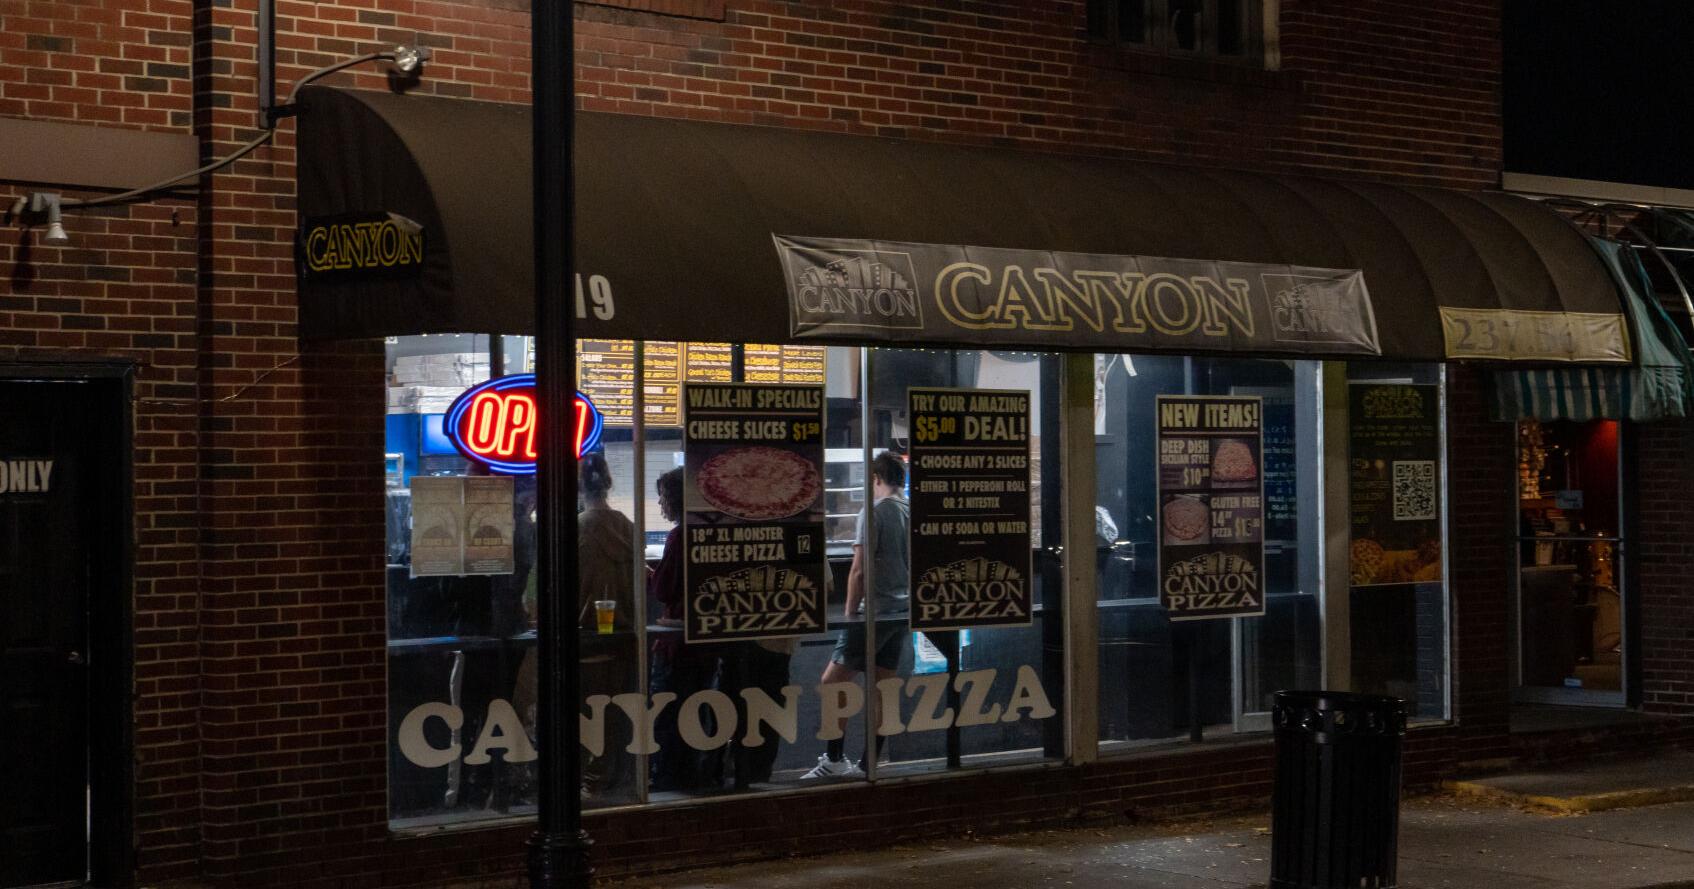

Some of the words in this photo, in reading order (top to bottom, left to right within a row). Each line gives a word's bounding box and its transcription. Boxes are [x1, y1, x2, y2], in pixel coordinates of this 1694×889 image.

[307, 219, 422, 271] CANYON
[800, 285, 916, 317] CANYON
[934, 261, 1255, 338] CANYON
[688, 388, 751, 408] WALK-IN
[757, 389, 821, 409] SPECIALS
[912, 395, 935, 411] TRY
[940, 395, 965, 412] OUR
[969, 396, 1026, 413] AMAZING
[467, 392, 587, 459] OP
[1161, 403, 1200, 428] NEW
[1204, 403, 1259, 428] ITEMS!
[689, 421, 739, 440] CHEESE
[744, 421, 787, 440] SLICES
[964, 416, 1026, 441] DEAL!
[1161, 440, 1185, 454] DEEP
[1187, 440, 1210, 454] DISH
[921, 455, 961, 469] CHOOSE
[963, 455, 985, 469] ANY
[987, 455, 994, 469] 2
[995, 455, 1026, 469] SLICES
[920, 481, 948, 493] EITHER
[951, 481, 957, 492] 1
[960, 481, 1004, 492] PEPPERONI
[1006, 480, 1026, 492] ROLL
[943, 497, 955, 509] OR
[957, 497, 964, 509] 2
[1210, 497, 1241, 509] GLUTEN
[1242, 496, 1260, 508] FREE
[717, 528, 730, 542] XL
[733, 527, 784, 541] MONSTER
[920, 523, 939, 535] CAN
[942, 522, 954, 534] OF
[955, 522, 980, 535] SODA
[982, 522, 995, 534] OR
[997, 521, 1027, 534] WATER
[1212, 527, 1233, 538] PIZZA
[691, 545, 739, 563] CHEESE
[744, 543, 786, 561] PIZZA
[916, 580, 1025, 604] CANYON
[1165, 573, 1258, 595] CANYON
[694, 589, 818, 615] CANYON
[919, 600, 1025, 621] PIZZA
[1168, 591, 1259, 612] PIZZA
[697, 611, 820, 634] PIZZA
[816, 664, 1056, 740] PIZZA
